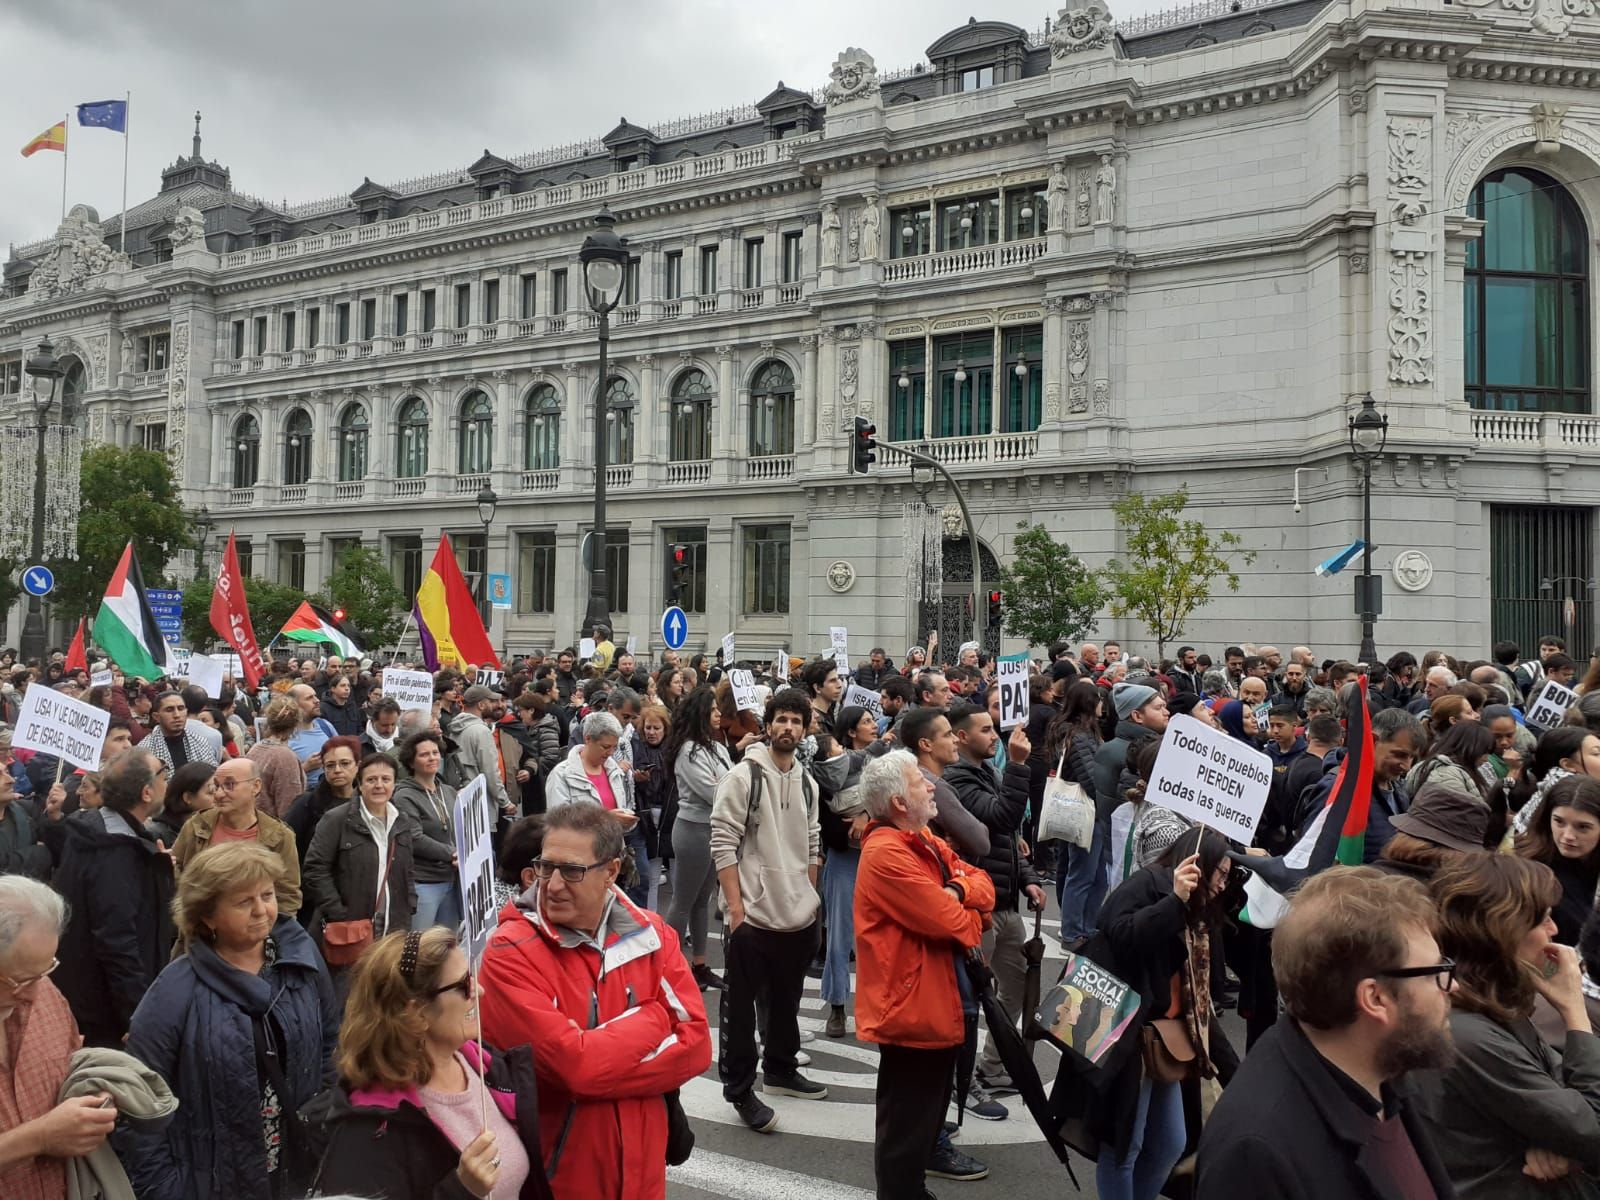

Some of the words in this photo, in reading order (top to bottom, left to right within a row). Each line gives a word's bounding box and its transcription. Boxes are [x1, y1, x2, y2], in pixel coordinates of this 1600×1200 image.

[172, 662, 189, 676] AZ
[34, 696, 52, 717] USA
[54, 702, 60, 719] Y
[58, 705, 69, 723] UE
[26, 723, 40, 742] DE
[39, 726, 65, 751] ISRAEL
[1172, 730, 1208, 757] Todos
[1210, 746, 1226, 765] los
[1227, 757, 1270, 786] pueblos
[1196, 764, 1245, 799] PIERDEN
[1158, 776, 1195, 802] todas
[1197, 790, 1214, 810] las
[1215, 802, 1253, 830] guerras.
[1072, 976, 1119, 1009] REVOLUTION
[1077, 965, 1124, 1002] SOCIAL
